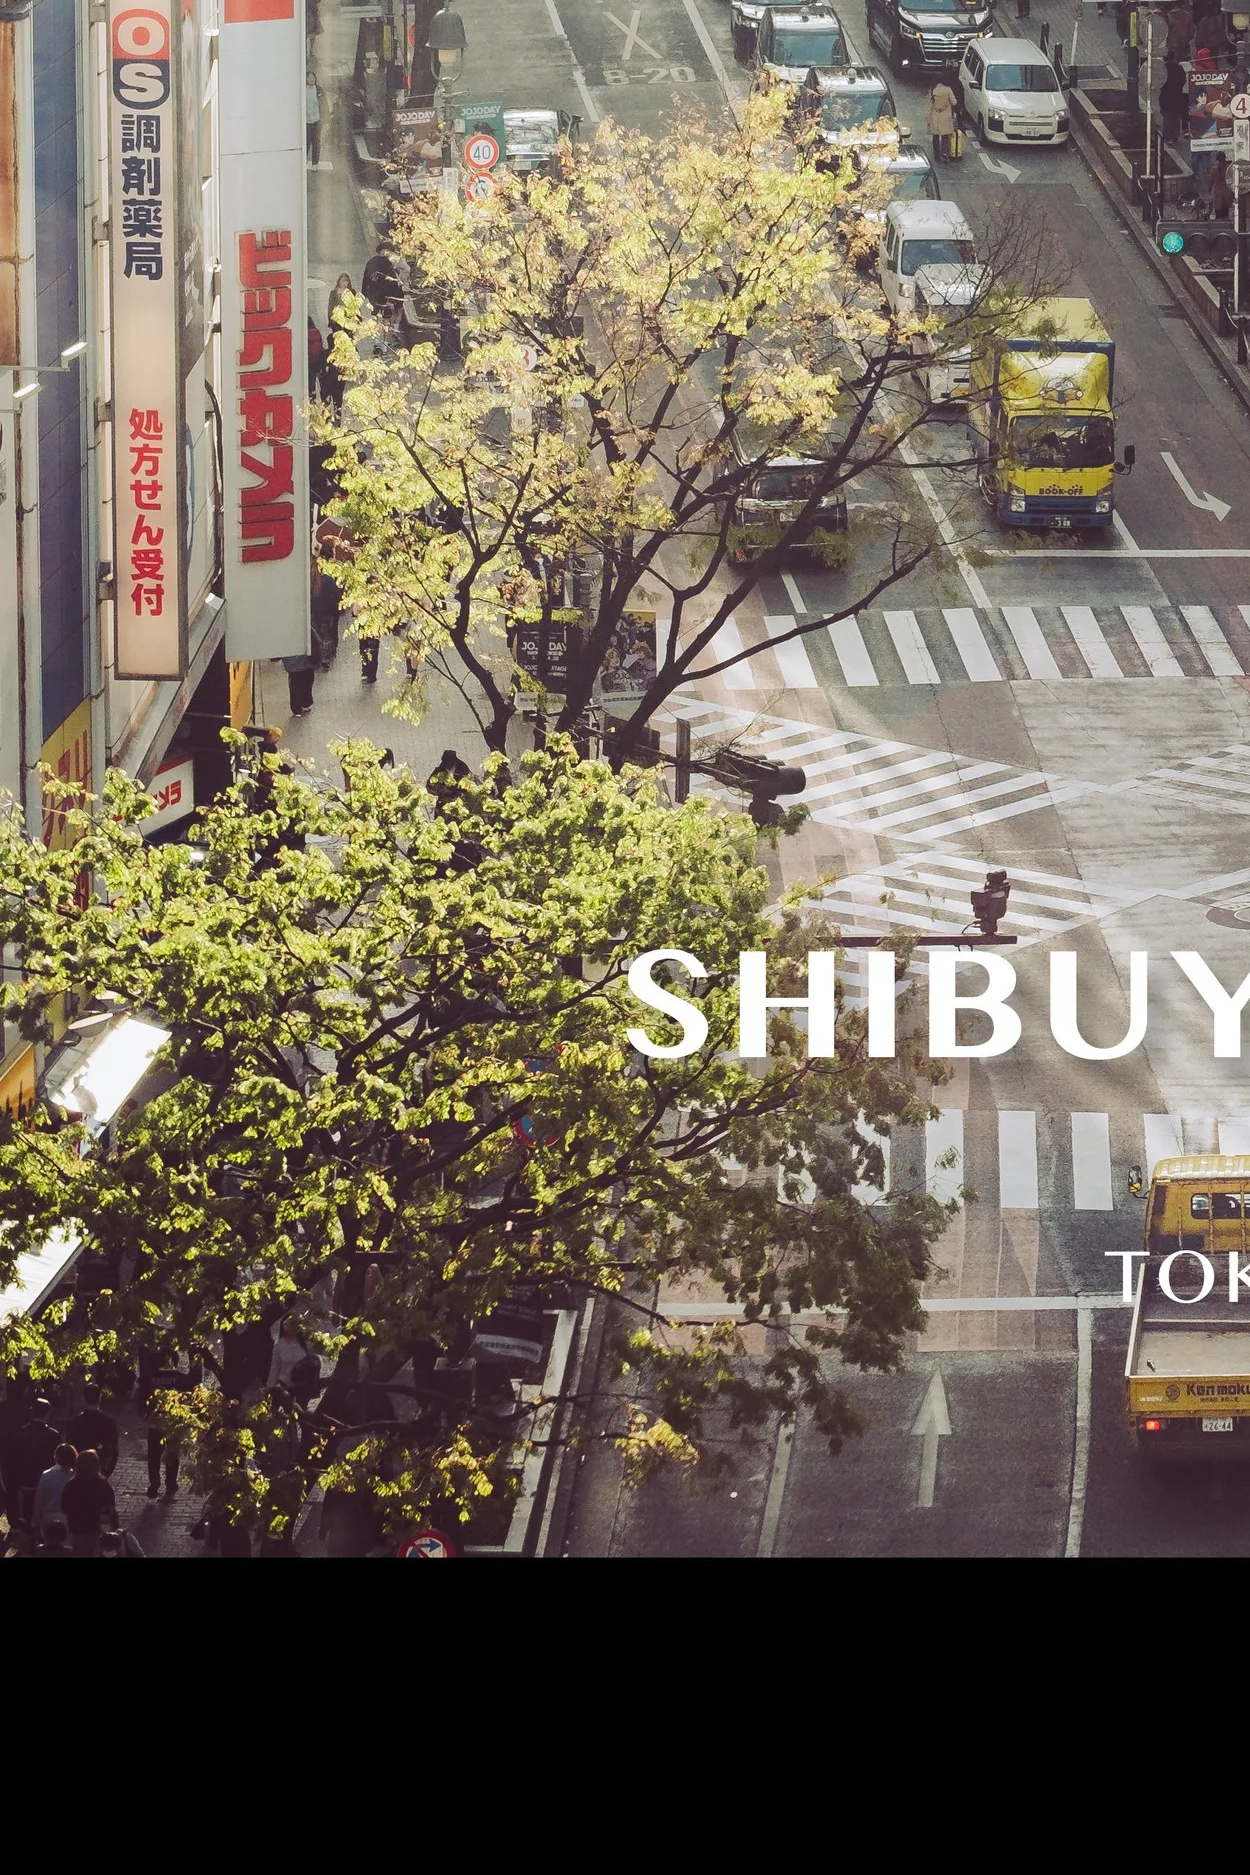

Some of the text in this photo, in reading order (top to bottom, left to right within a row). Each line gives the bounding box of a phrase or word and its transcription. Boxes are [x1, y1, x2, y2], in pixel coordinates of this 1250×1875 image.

[115, 11, 168, 105] OS
[602, 67, 697, 86] 8-20
[1235, 97, 1248, 115] 4
[473, 145, 492, 161] 40
[120, 113, 164, 282] 調剤薬局
[237, 228, 296, 565] ビックカメラ
[1038, 486, 1084, 496] BOOK-OFF
[128, 408, 166, 617] 処方せん受付
[1208, 1421, 1232, 1431] 26-44
